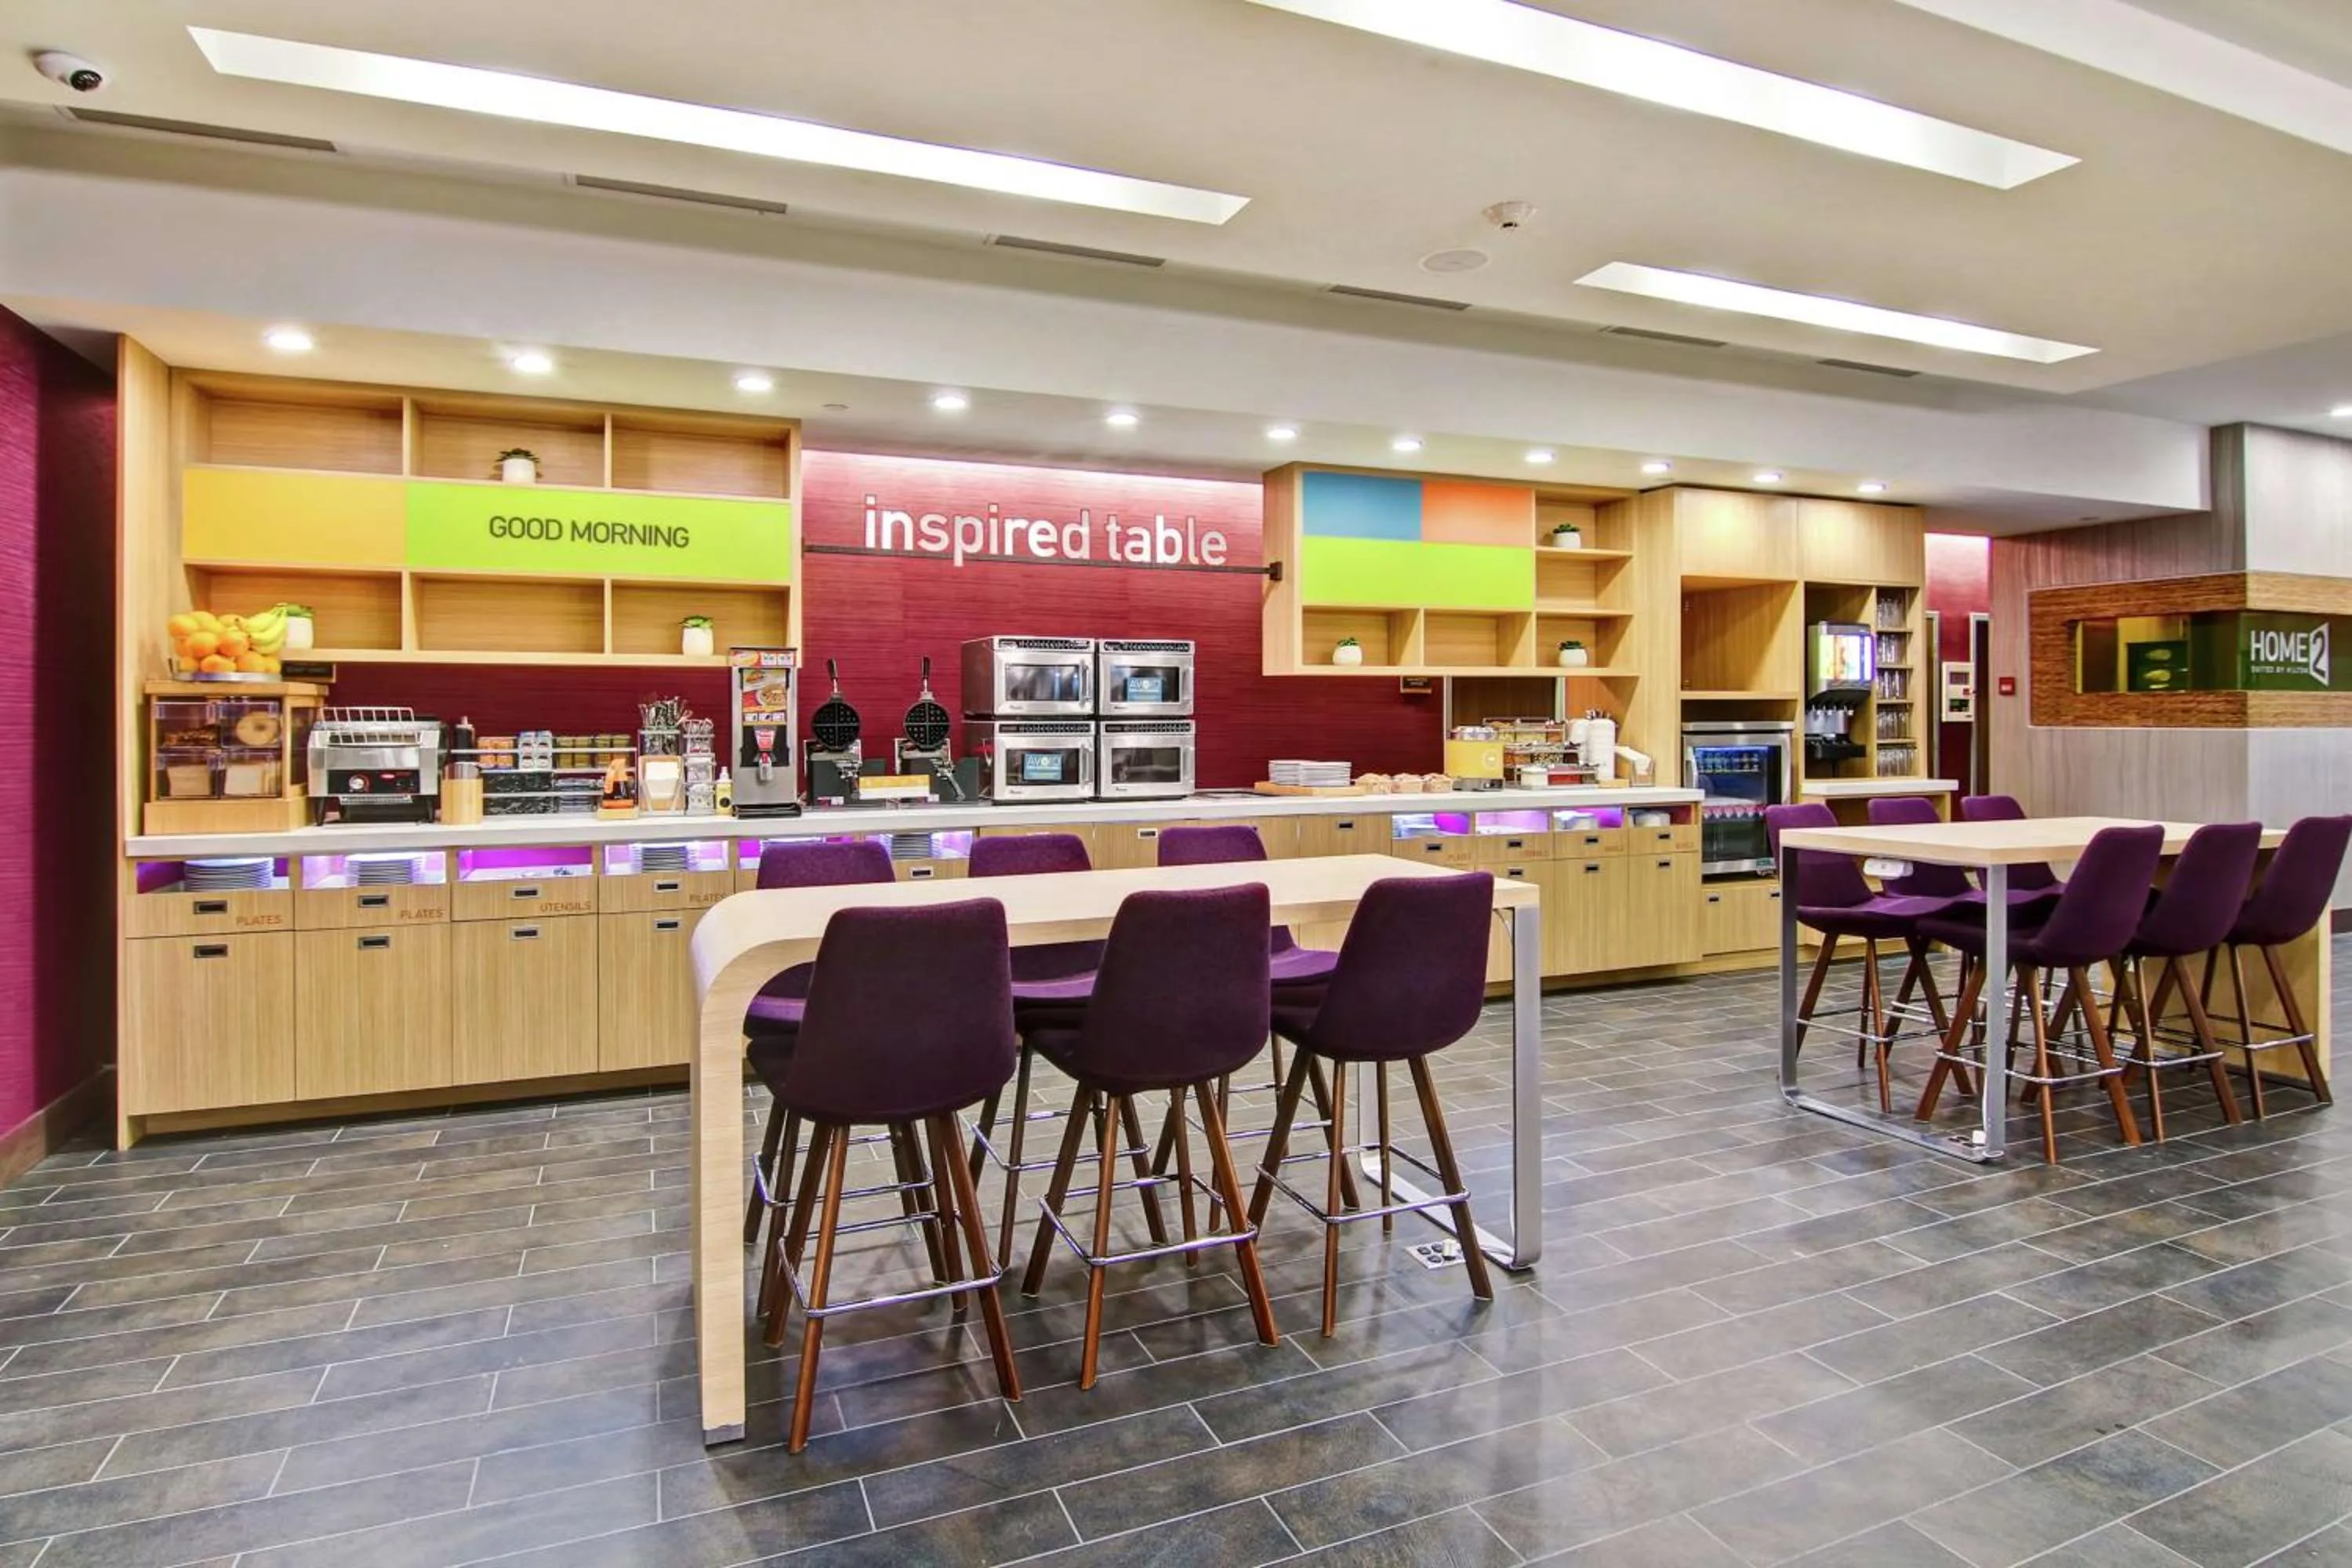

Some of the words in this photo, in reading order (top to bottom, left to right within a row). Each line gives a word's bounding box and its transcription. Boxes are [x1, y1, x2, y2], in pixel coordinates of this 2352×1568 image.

[489, 516, 562, 541] GOOD
[570, 520, 690, 548] MORNING
[865, 493, 1091, 567] inspired
[1105, 514, 1228, 566] table
[539, 901, 591, 912] UTENSILS
[401, 908, 444, 919] PLATES
[236, 915, 282, 926] PLATES
